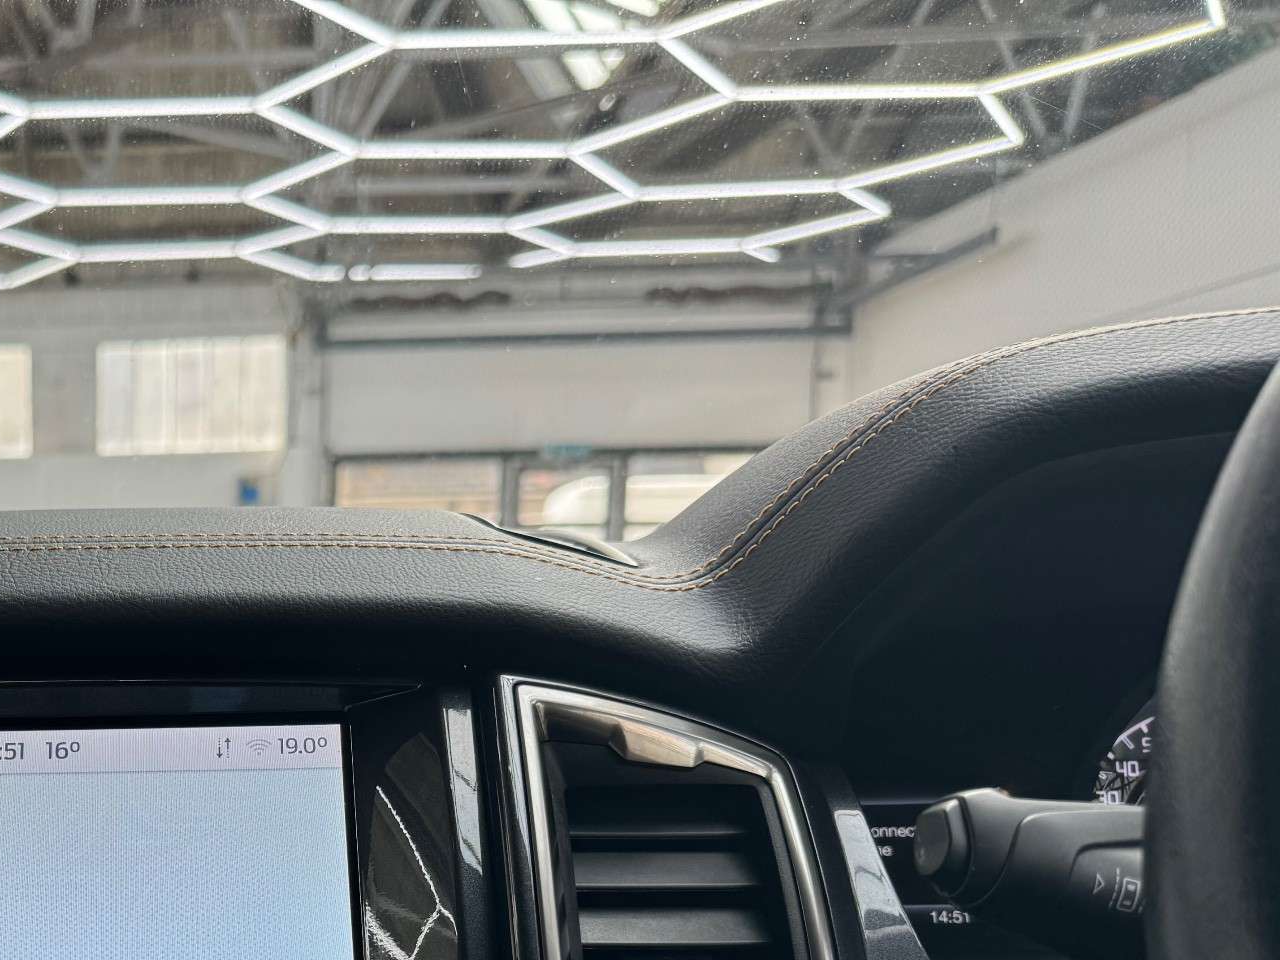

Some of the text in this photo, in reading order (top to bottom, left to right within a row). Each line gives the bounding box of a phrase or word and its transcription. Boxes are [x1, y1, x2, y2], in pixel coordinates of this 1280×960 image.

[1115, 760, 1140, 777] 40
[870, 826, 917, 838] onnec
[930, 910, 971, 924] 14:51
